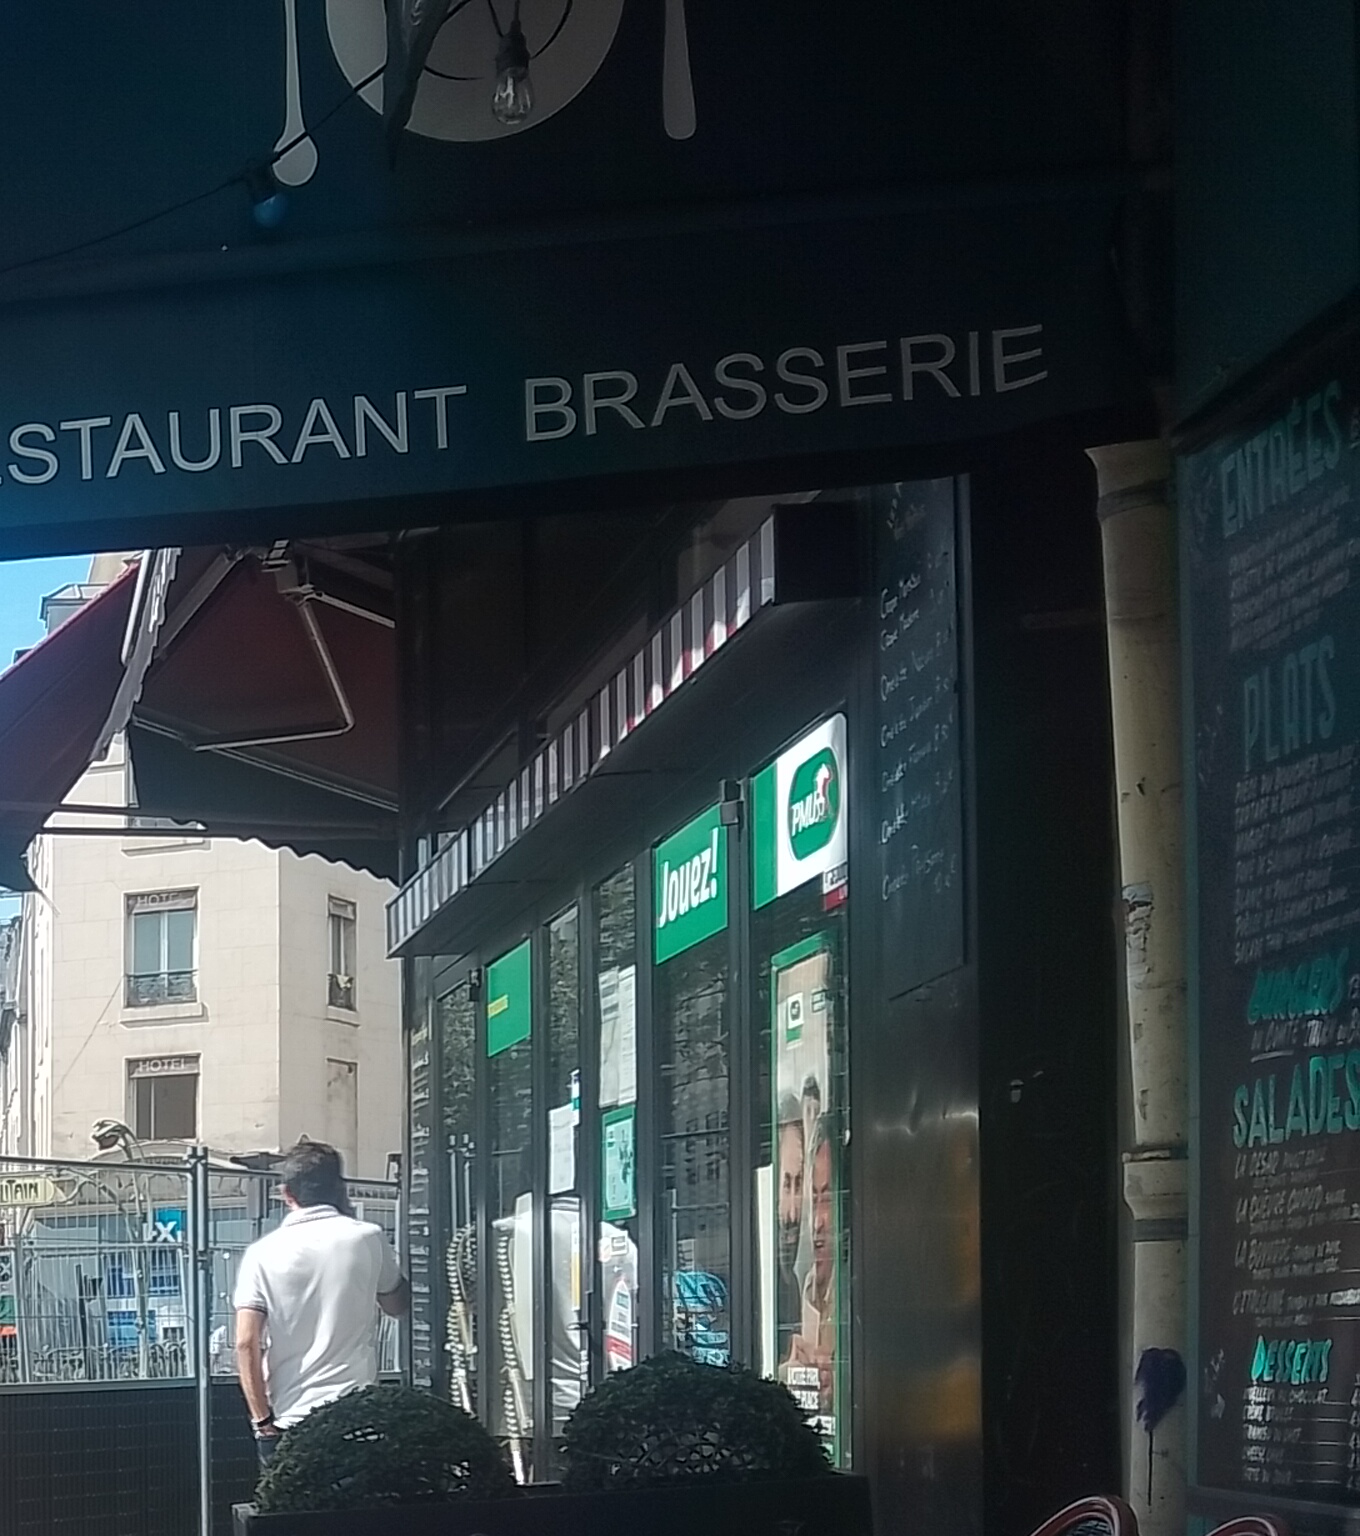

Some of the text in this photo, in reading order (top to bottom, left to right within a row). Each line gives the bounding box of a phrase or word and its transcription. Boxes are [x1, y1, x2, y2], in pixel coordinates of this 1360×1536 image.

[523, 322, 1050, 442] BRASSERIE
[1243, 635, 1335, 772] PLATS
[658, 827, 720, 929] Jouez!
[1232, 1049, 1360, 1149] SALADES
